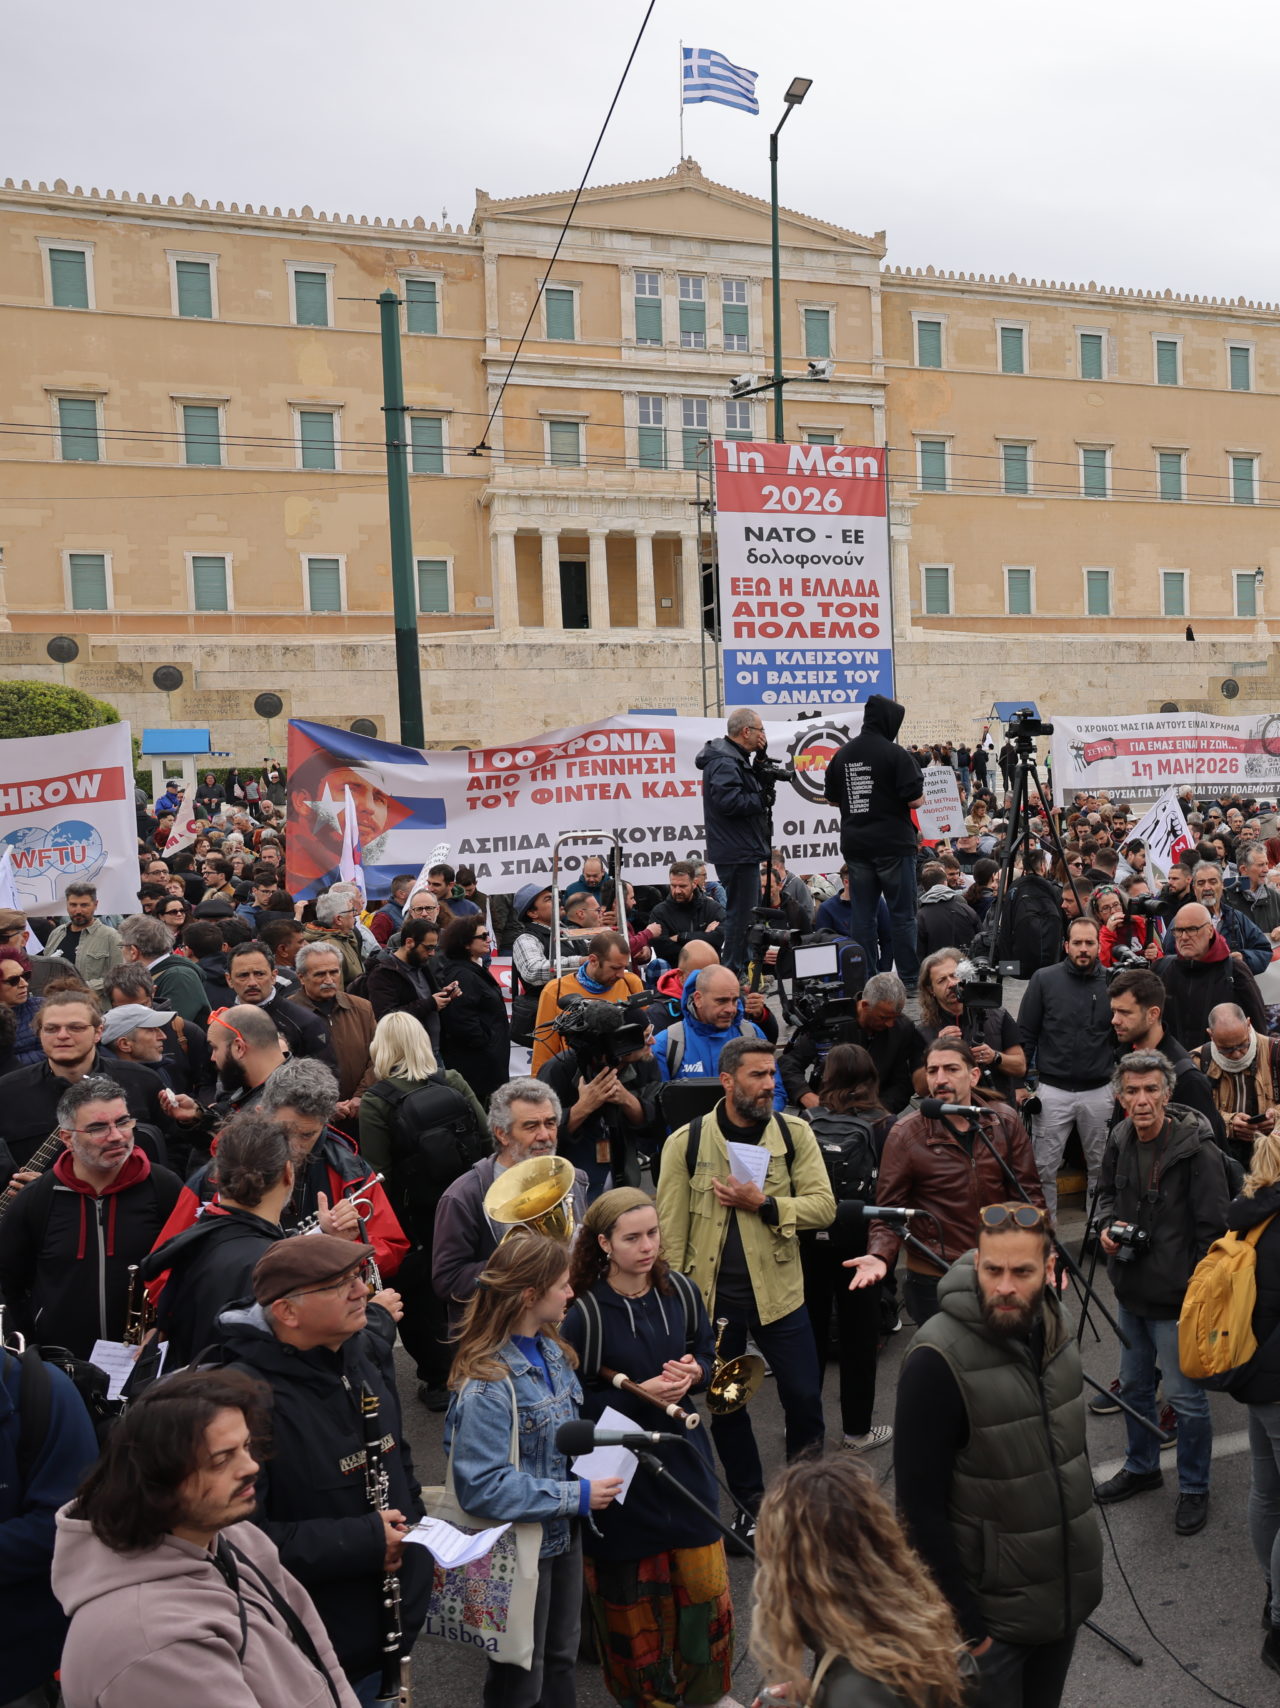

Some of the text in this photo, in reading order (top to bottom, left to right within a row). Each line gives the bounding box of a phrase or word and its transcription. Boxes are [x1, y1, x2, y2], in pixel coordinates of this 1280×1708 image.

[761, 485, 843, 512] 2026
[744, 526, 816, 543] ΝΑΤΟ
[841, 529, 864, 544] ΕΕ
[746, 548, 865, 569] δολοφονούν
[730, 577, 880, 597] ΕΞΩ Η ΕΛΛΑΔΑ
[732, 601, 879, 618] ΑΠΟ ΤΟΝ
[733, 621, 880, 639] ΠΟΛΕΜΟ
[736, 651, 879, 665] ΝΑ ΚΛΕΙΣΟΥΝ
[736, 670, 880, 685] ΟΙ ΒΑΣΕΙΣ ΤΟΥ
[761, 689, 859, 704] ΘΑΝΑΤΟΥ
[1076, 720, 1240, 733] Ο ΧΡΟΝΟΣ ΜΑΣ ΓΙΑ ΑΥΤΟΥΣ ΕΙΝΑΙ ΧΡΗΜΑ
[1130, 741, 1146, 752] ΓΙΑ
[1148, 740, 1175, 751] ΕΜΑΣ
[1176, 739, 1199, 750] ΕΙΝΑΙ
[1200, 739, 1207, 749] Η
[471, 749, 536, 770] 100
[466, 757, 676, 791] ΑΠΟ ΤΗ ΓΕΝΝΗΣΗ
[1131, 760, 1153, 780] 1η
[466, 790, 520, 810] ΤΟΥ
[530, 782, 631, 804] ΦΙΝΤΕΛ
[1138, 789, 1152, 798] ΓΙΑ
[1207, 785, 1228, 794] ΤΟΥΣ
[1230, 784, 1275, 793] ΠΟΛΕΜΟΥΣ
[458, 833, 551, 855] ΑΣΠΙΔΑ
[612, 824, 706, 844] ΚΟΥΒΑΣ
[783, 820, 805, 836] ΟΙ
[813, 818, 841, 834] ΛΑ
[11, 845, 87, 869] WFTU
[622, 851, 677, 868] ΤΩΡΑ
[425, 1616, 500, 1653] Lisboa
